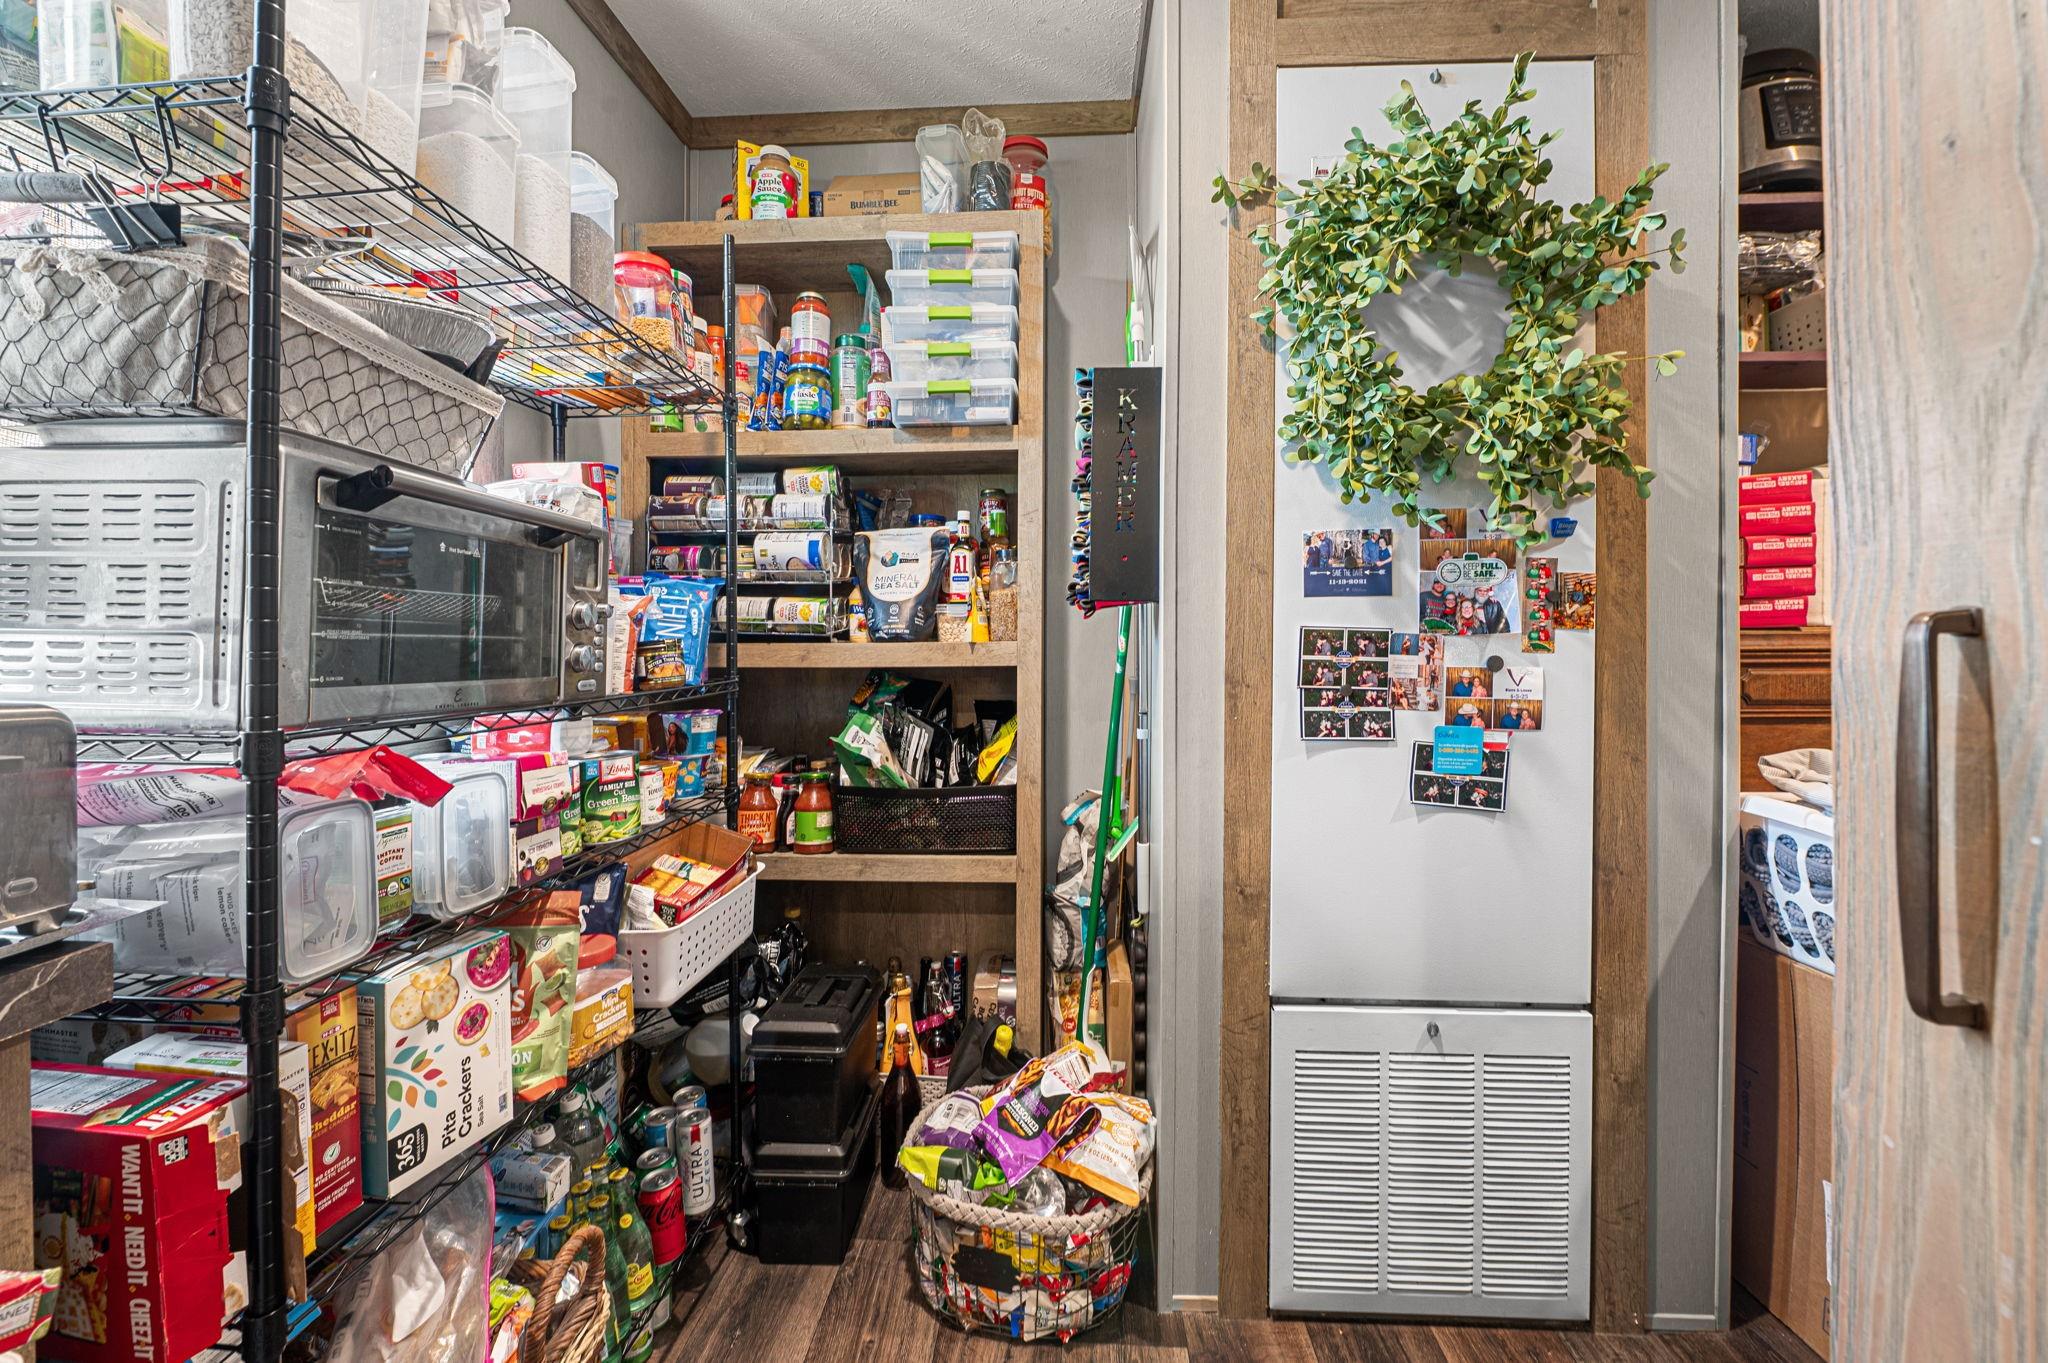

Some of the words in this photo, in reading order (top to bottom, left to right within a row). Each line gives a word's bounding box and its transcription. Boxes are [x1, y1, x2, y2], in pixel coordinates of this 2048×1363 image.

[757, 177, 782, 187] Apple
[757, 185, 782, 194] Sauce
[850, 200, 883, 209] BUMBLE
[884, 199, 900, 208] BEE
[1114, 388, 1139, 533] KRAMER
[1343, 568, 1352, 577] THE
[1462, 562, 1480, 571] KEEP
[1480, 562, 1503, 571] FULL.
[1462, 570, 1472, 578] BE
[1473, 570, 1497, 578] SAFE.
[874, 572, 919, 584] MINERAL
[874, 582, 893, 591] SEA
[895, 581, 920, 590] SALT
[656, 594, 693, 639] THIN
[137, 777, 160, 802] Calories
[598, 783, 624, 792] FAMILY
[624, 780, 636, 788] SIZE
[613, 788, 626, 796] Cut
[173, 803, 190, 818] 100
[587, 797, 619, 809] Green
[376, 847, 406, 860] INSTANT
[379, 855, 404, 866] COFFEE
[217, 886, 227, 915] lemon
[221, 916, 232, 938] cake
[953, 973, 962, 1012] ULTRA
[601, 994, 620, 1010] Mini
[592, 1001, 628, 1024] Crackers
[458, 1055, 473, 1139] Crackers
[441, 1110, 456, 1149] Pita
[395, 1133, 416, 1171] 365
[121, 1144, 142, 1198] WANT
[690, 1145, 704, 1199] ULTRA
[124, 1226, 146, 1270] NEED
